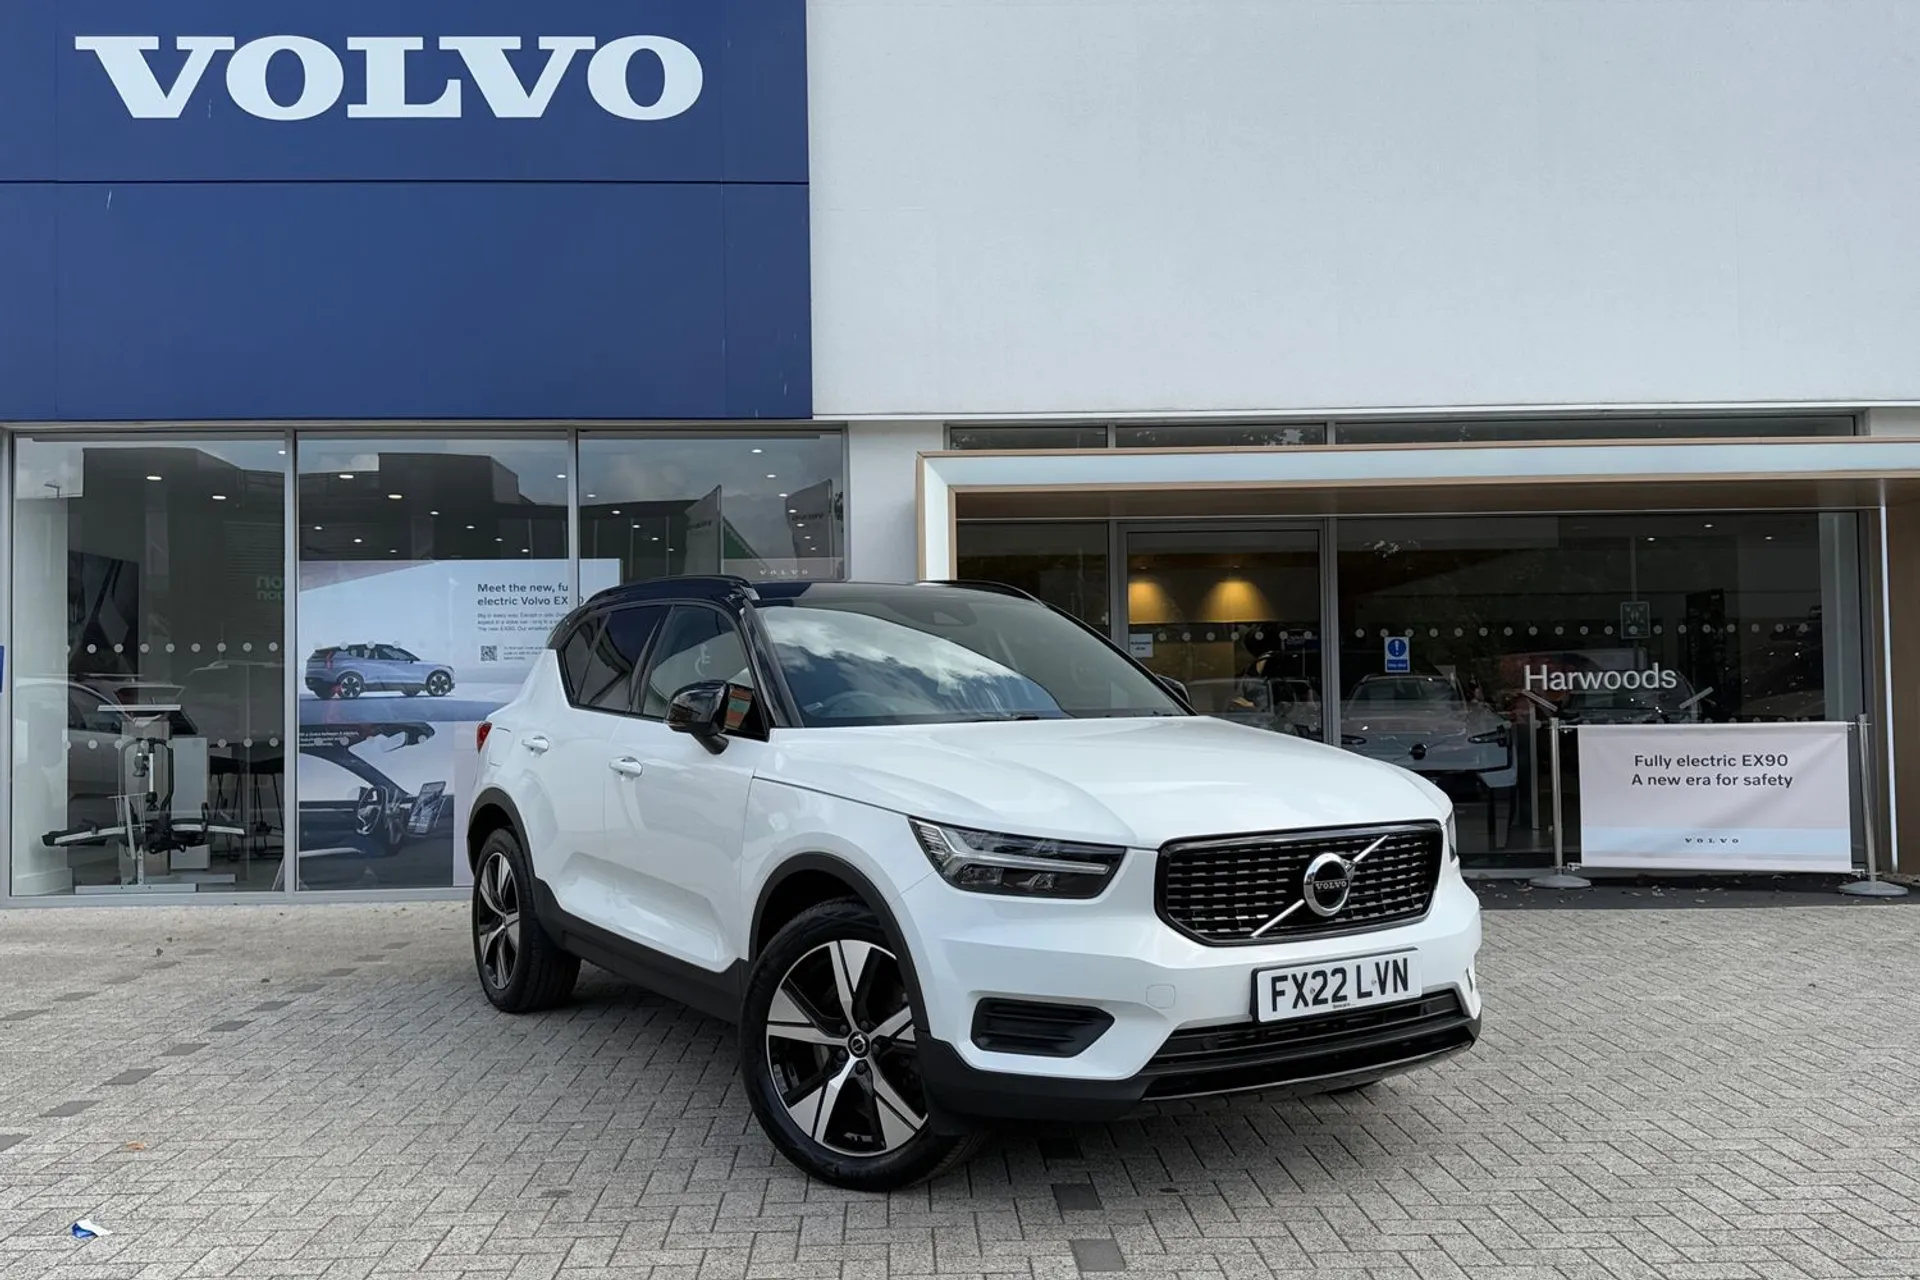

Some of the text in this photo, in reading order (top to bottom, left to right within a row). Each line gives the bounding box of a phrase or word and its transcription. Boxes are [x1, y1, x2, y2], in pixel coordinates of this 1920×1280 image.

[74, 35, 704, 120] VOLVO
[477, 582, 569, 593] Meet the new, fu
[477, 596, 518, 606] electric
[520, 596, 551, 606] Volvo
[1523, 662, 1677, 691] Harwoods
[1634, 753, 1789, 769] Fully electric EX90
[1631, 773, 1793, 788] A new era for safety
[1315, 880, 1347, 890] VOLVO
[1270, 957, 1409, 1012] FX22 LVN
